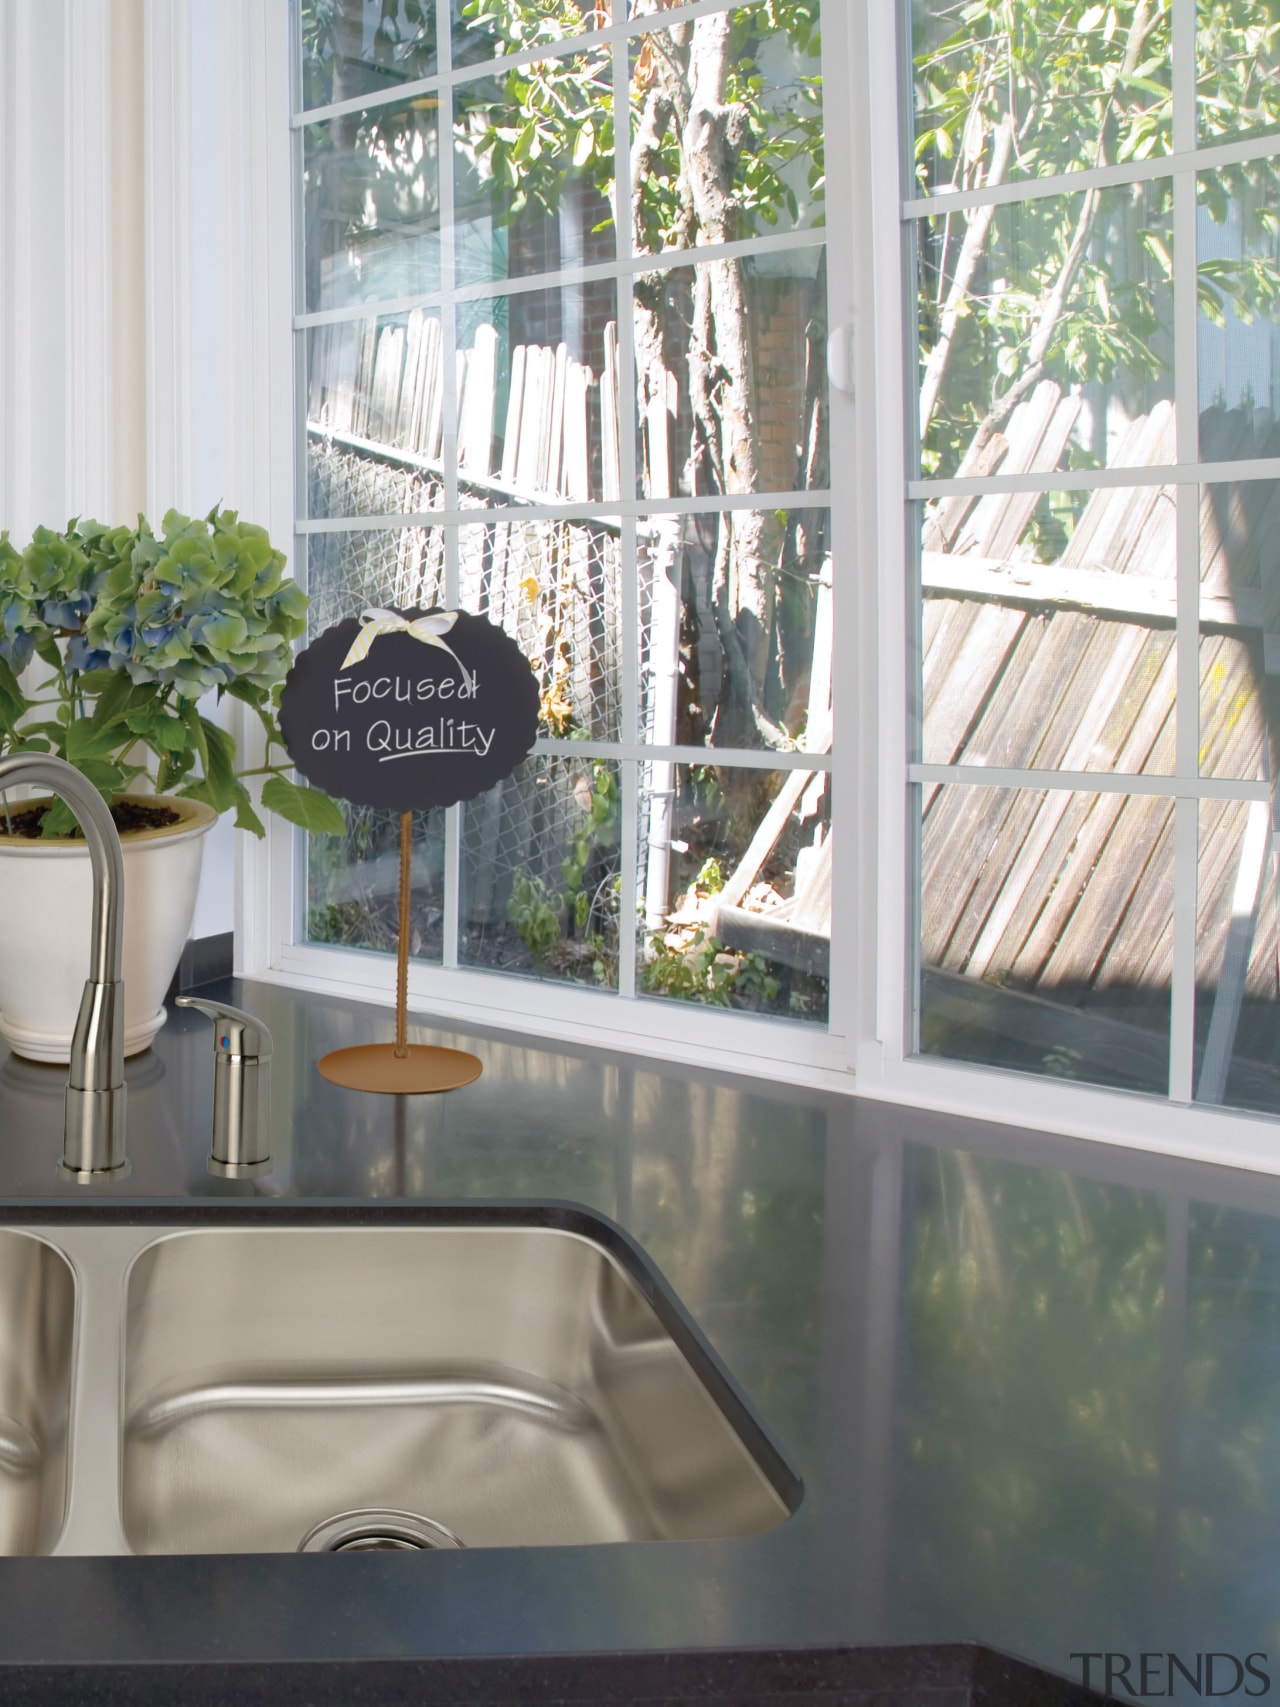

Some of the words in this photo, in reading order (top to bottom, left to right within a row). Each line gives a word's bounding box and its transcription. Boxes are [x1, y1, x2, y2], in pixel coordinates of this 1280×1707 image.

[334, 669, 481, 713] Focused
[311, 729, 351, 751] on
[366, 717, 496, 756] Quality
